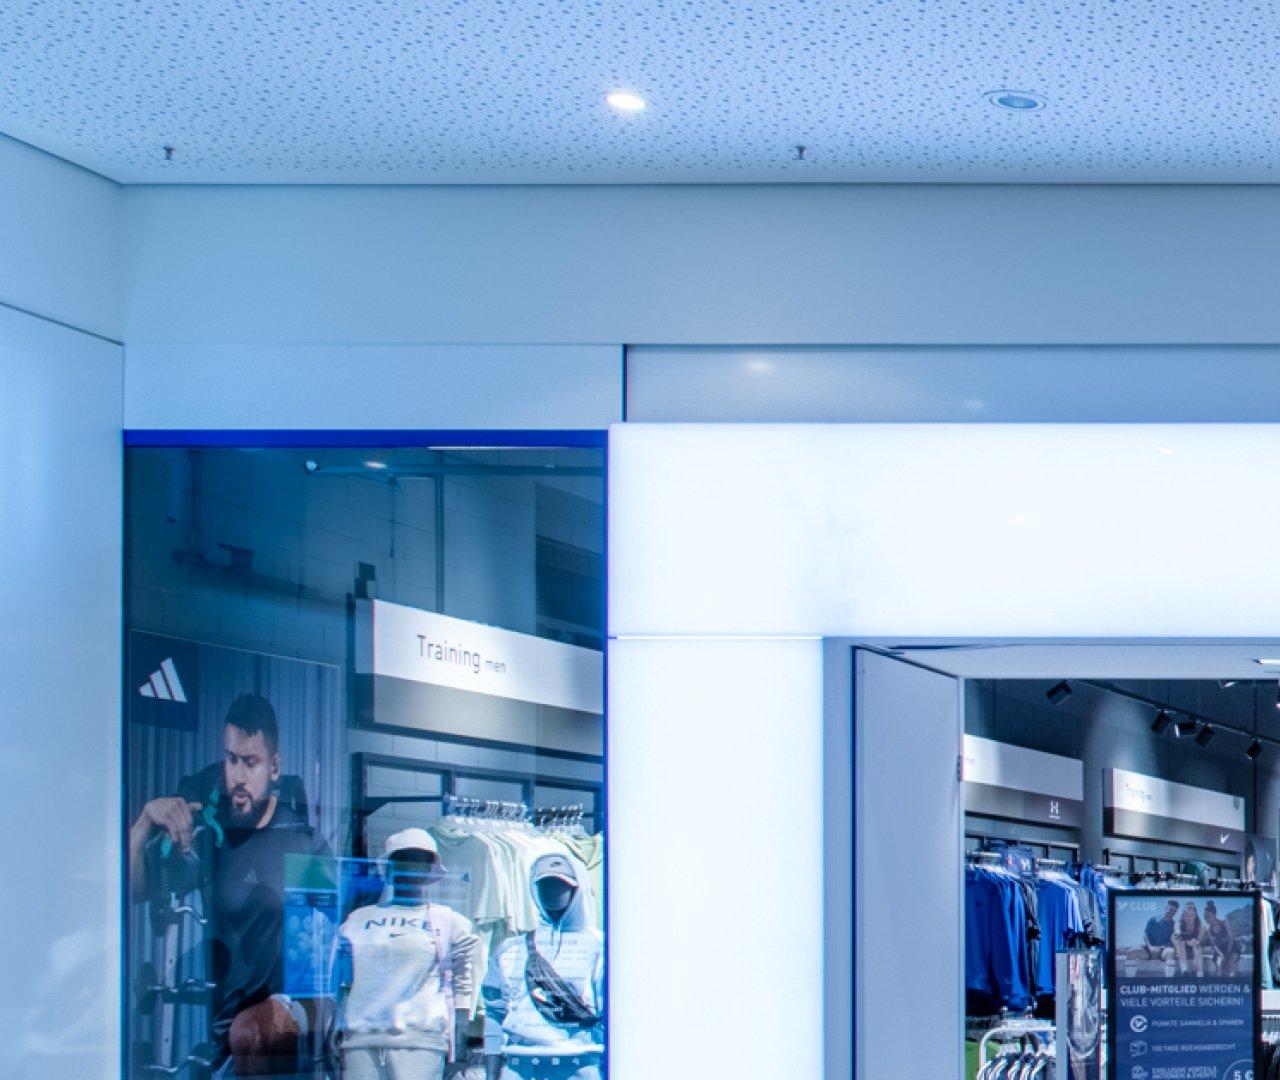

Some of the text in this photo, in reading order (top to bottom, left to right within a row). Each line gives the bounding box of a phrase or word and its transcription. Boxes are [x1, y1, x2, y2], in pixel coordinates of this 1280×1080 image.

[417, 633, 480, 673] Training
[1129, 901, 1157, 911] CLUB
[365, 917, 432, 931] NIKE
[1119, 984, 1251, 995] CLUB-MITGLIED WERDEN &
[1120, 997, 1244, 1007] VIELE VORTEILE SICHERN!
